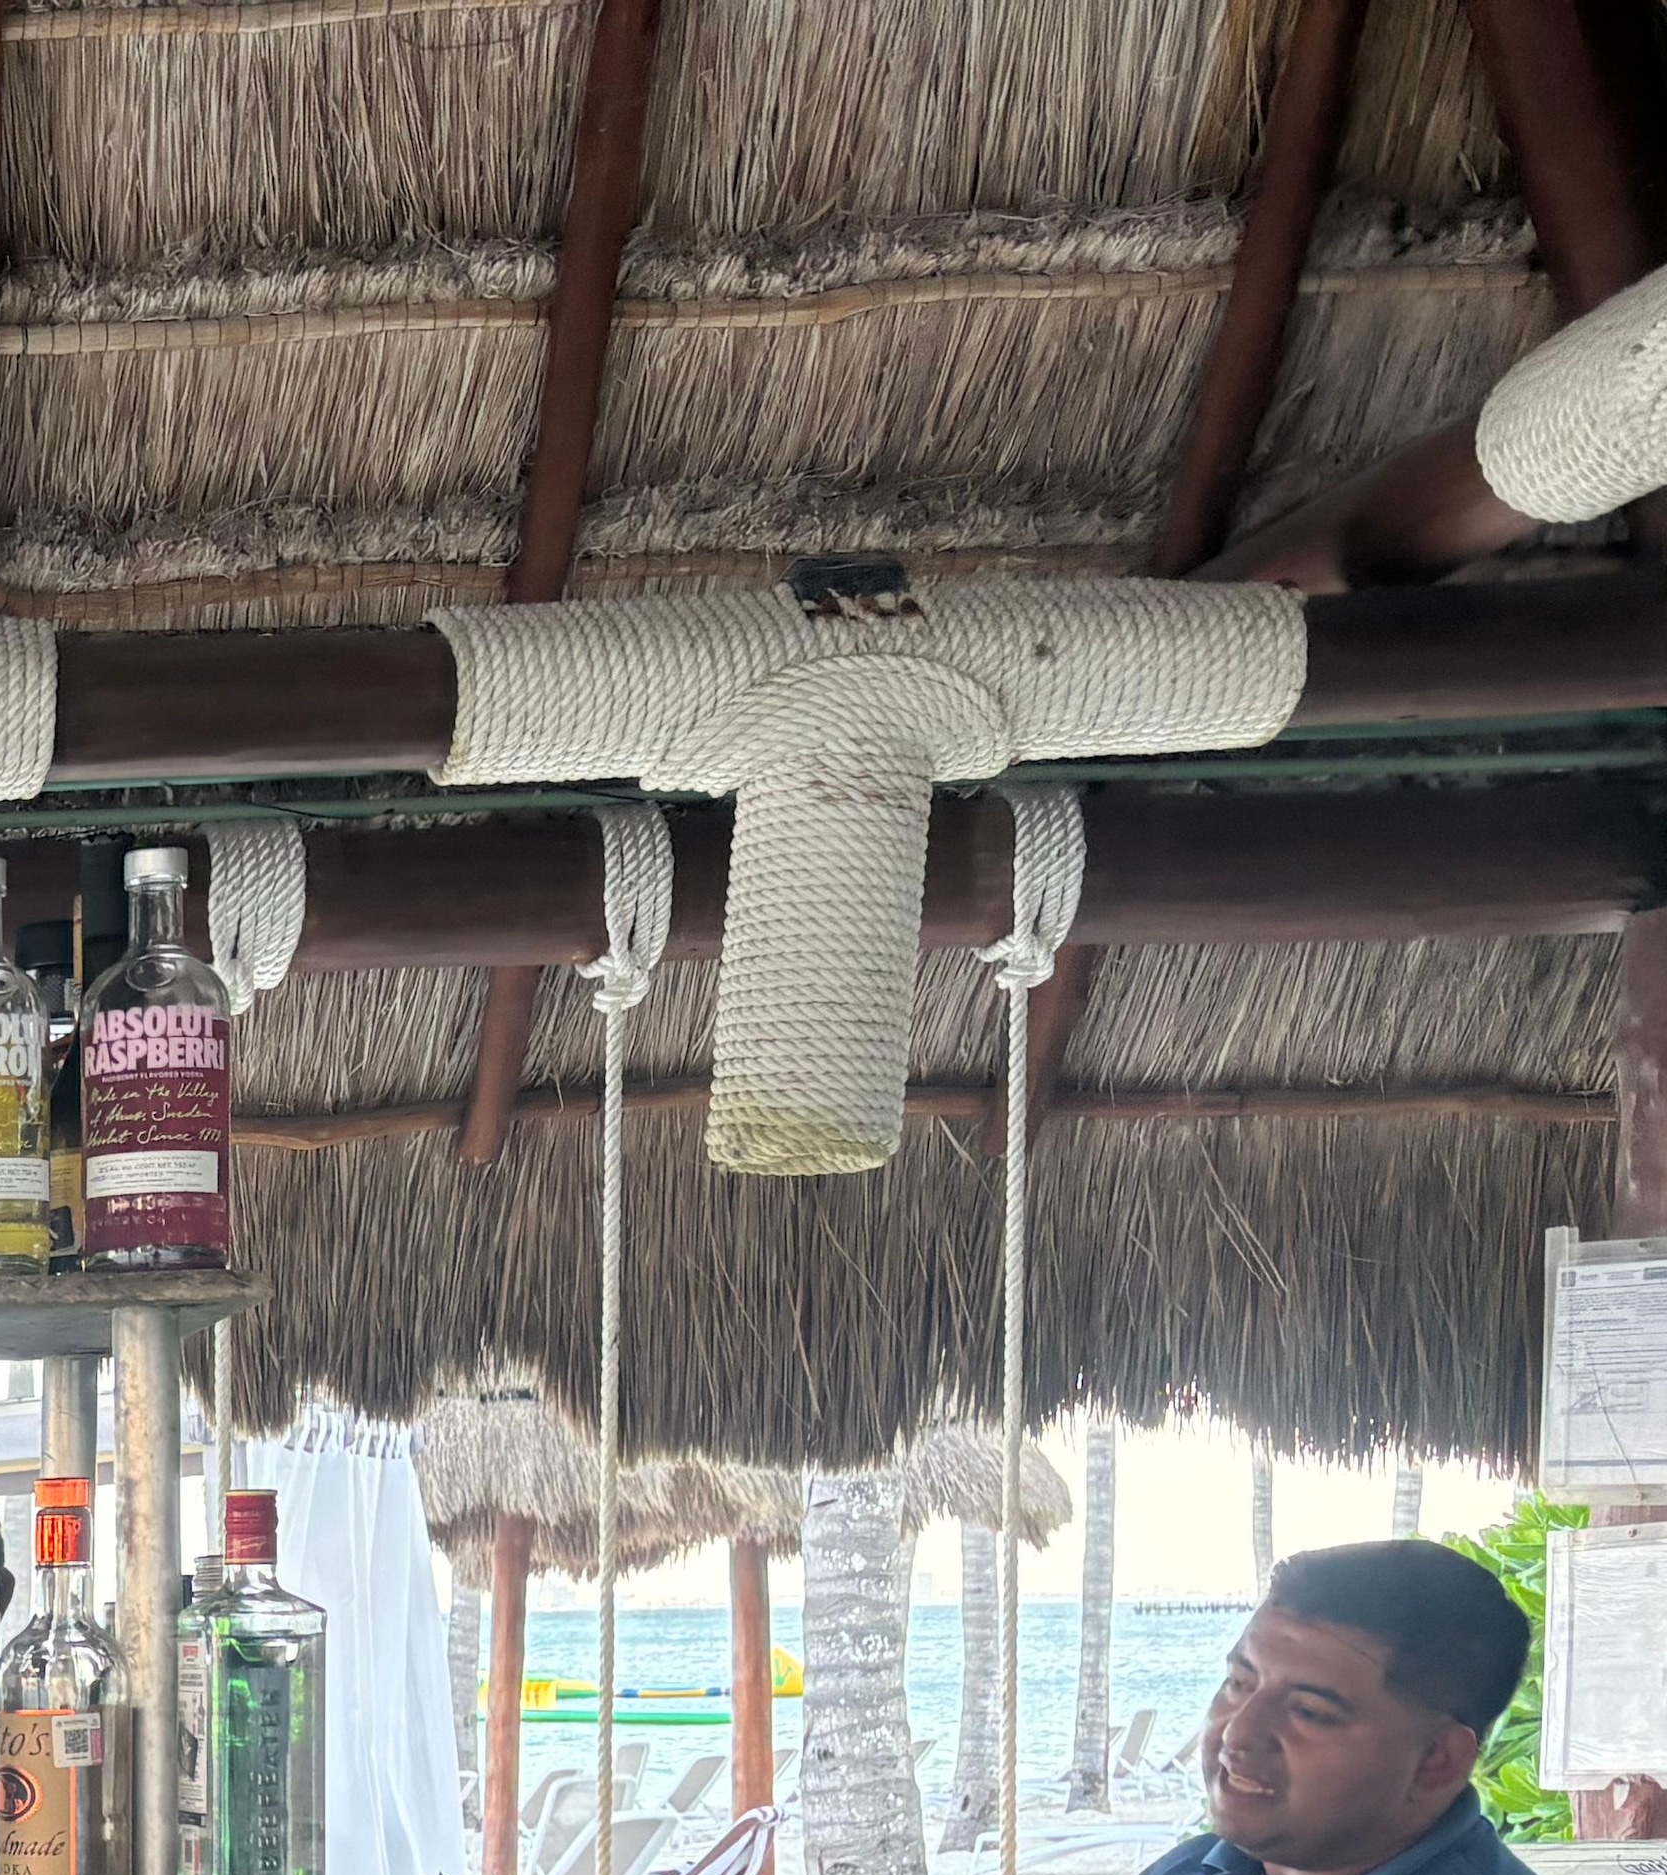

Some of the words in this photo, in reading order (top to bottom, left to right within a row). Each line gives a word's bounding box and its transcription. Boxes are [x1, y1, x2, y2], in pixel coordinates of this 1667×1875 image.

[92, 1005, 215, 1044] ABSOLUT
[84, 1037, 225, 1077] RASPBERRI
[257, 1689, 280, 1872] BEEFEATER
[0, 1830, 65, 1856] dmade
